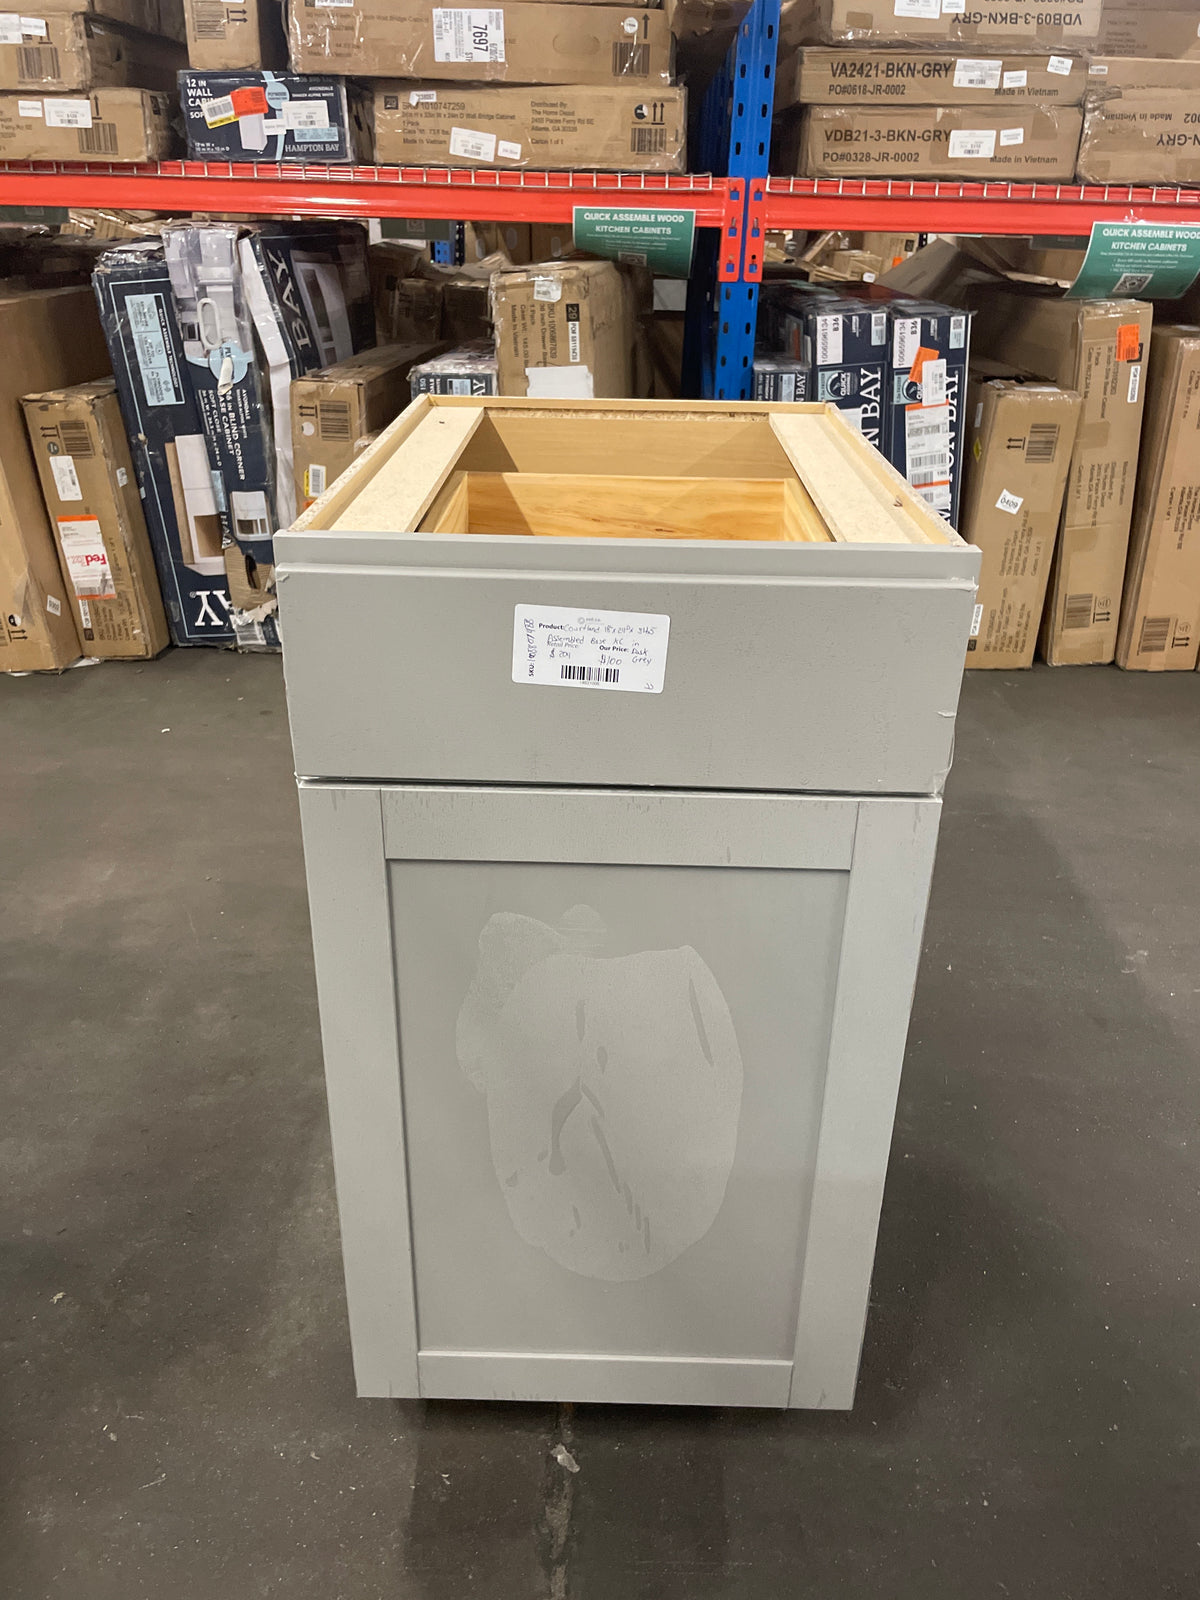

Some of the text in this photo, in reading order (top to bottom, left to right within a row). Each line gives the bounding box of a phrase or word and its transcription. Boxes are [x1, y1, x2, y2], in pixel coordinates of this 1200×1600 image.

[952, 12, 1082, 26] VDB09-3-BKN-GRY
[472, 24, 488, 52] 7697
[830, 62, 952, 79] VA2421-BKN-GRY
[186, 79, 197, 87] 12
[187, 88, 213, 96] WALL
[994, 88, 1058, 97] Made in Vietnam
[1139, 113, 1147, 121] in
[1149, 113, 1173, 121] Made
[824, 129, 951, 142] VDB21-3-BKN-GRY
[285, 143, 339, 152] HAMPTON BAY
[822, 152, 919, 163] PO#0328-JR-0002
[990, 155, 1058, 164] Made in Vietnam
[584, 212, 685, 223] QUICK ASSEMBLE WOOD
[595, 225, 671, 235] KITCHEN CABINETS
[1103, 228, 1130, 237] QUICK
[1131, 229, 1174, 239] ASSEMBLE
[1111, 241, 1187, 252] KITCHEN CABINETS
[267, 249, 312, 350] BAY
[795, 374, 806, 395] BAY
[860, 367, 881, 420] BAY
[208, 390, 217, 410] SOFT
[242, 389, 251, 420] AVONDALE
[218, 394, 235, 455] ASE CABINET
[228, 412, 239, 440] BLIND
[234, 443, 245, 481] CORNER
[538, 622, 563, 630] Product:
